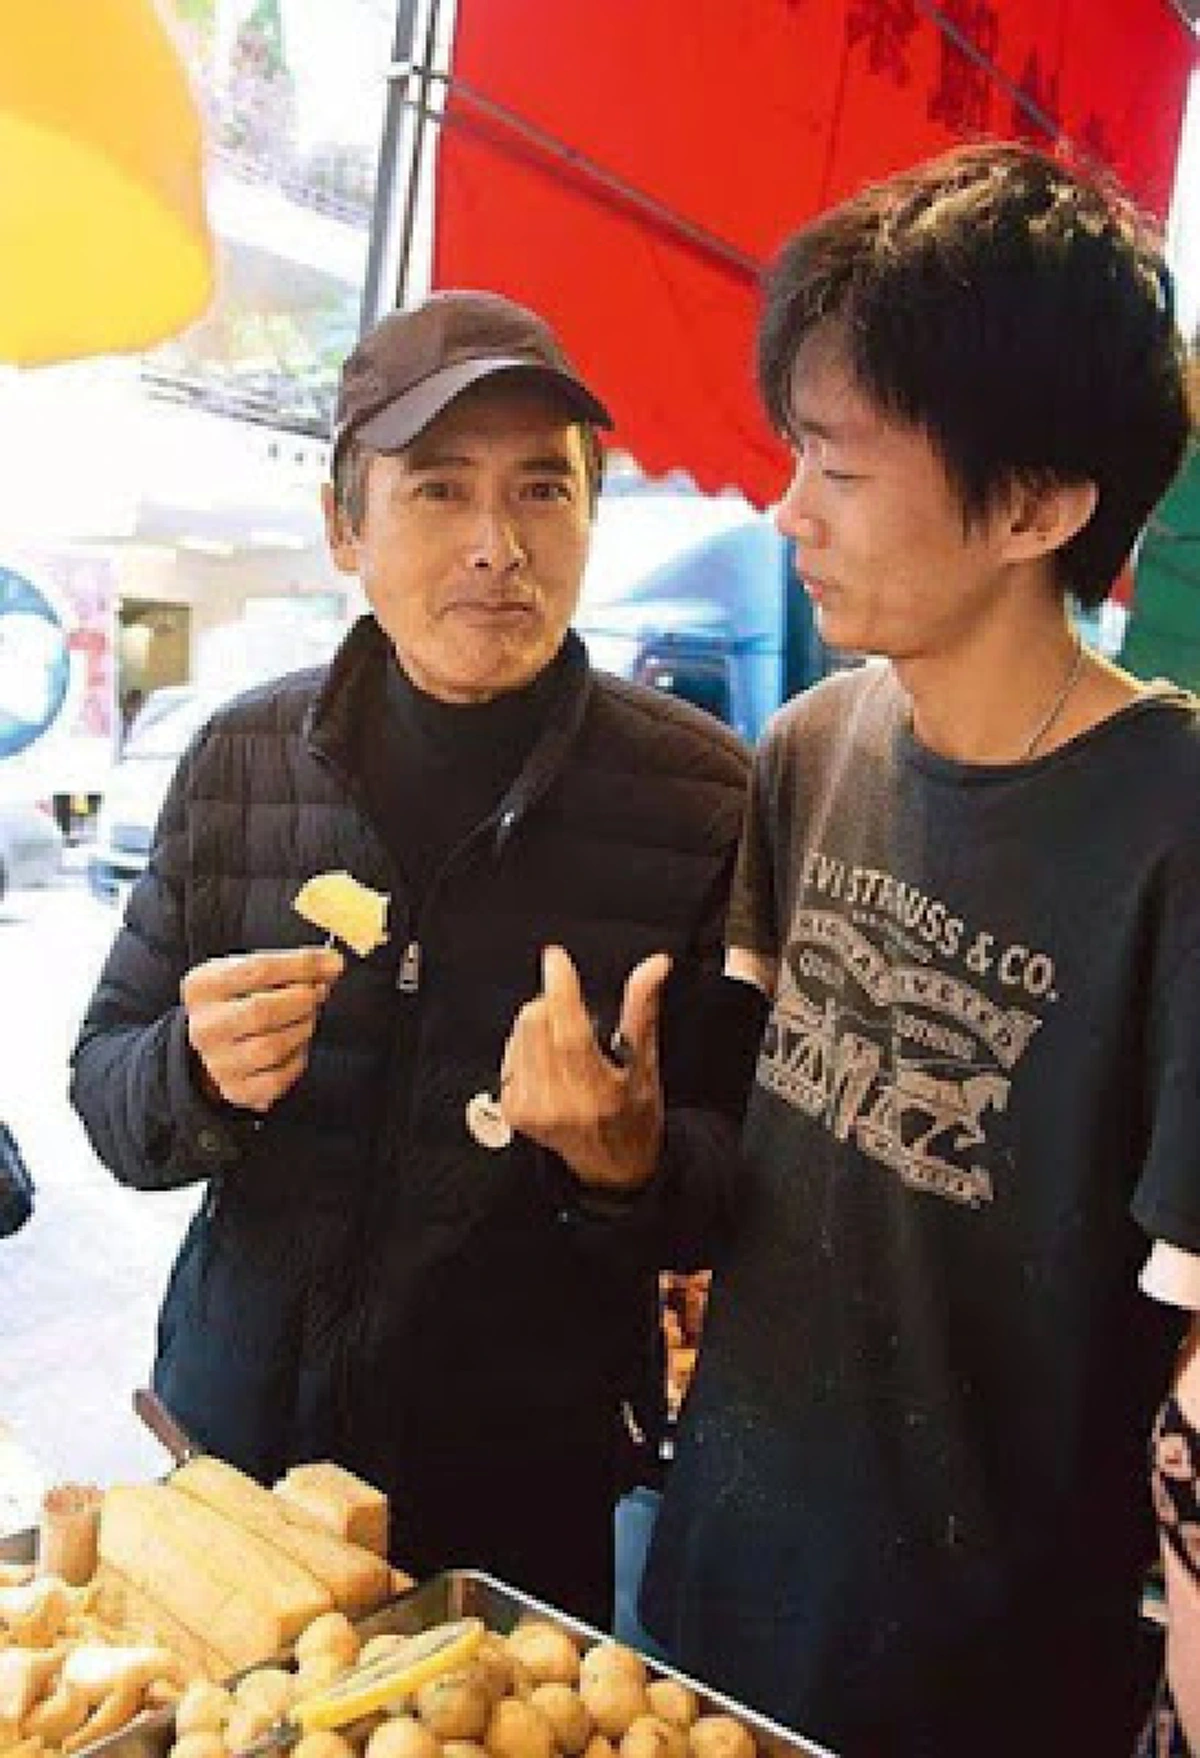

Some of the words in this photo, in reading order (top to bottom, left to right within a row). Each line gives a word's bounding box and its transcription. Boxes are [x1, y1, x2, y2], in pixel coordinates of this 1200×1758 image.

[801, 850, 843, 898] EVI
[966, 931, 995, 976] &
[999, 944, 1059, 1002] CO.
